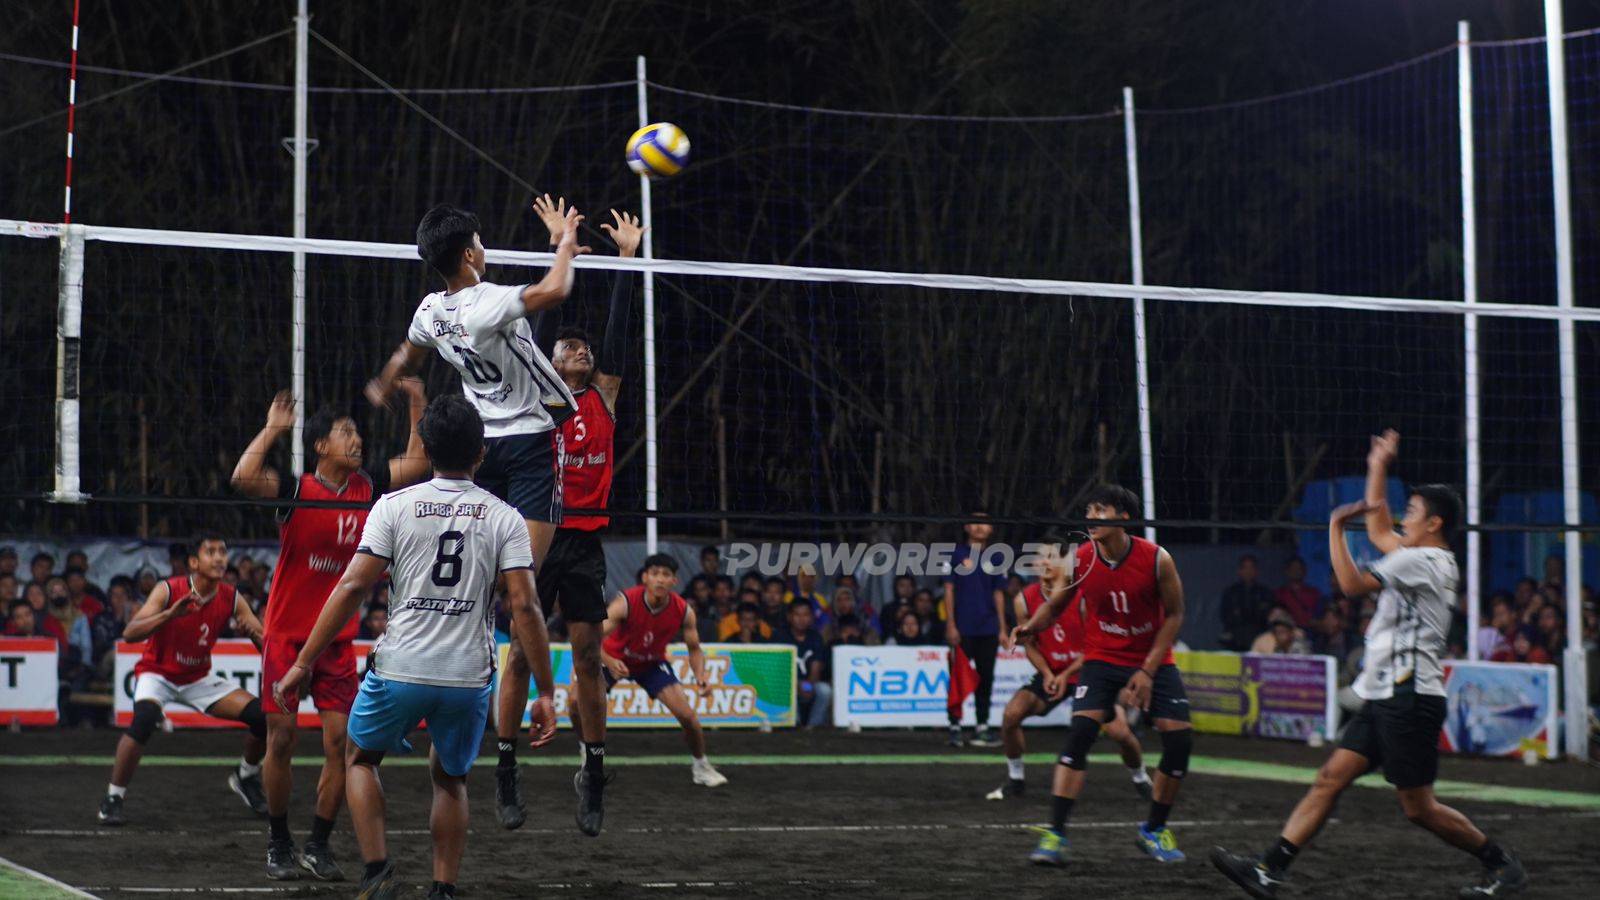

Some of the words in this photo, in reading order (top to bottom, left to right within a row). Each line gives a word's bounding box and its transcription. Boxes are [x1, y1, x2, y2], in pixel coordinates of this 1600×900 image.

[415, 501, 452, 518] RIMBA
[337, 513, 358, 544] 12
[431, 530, 465, 587] 8
[407, 597, 475, 616] PLATINUM
[1109, 591, 1130, 614] 11
[199, 623, 209, 646] 2
[848, 670, 950, 695] NBM
